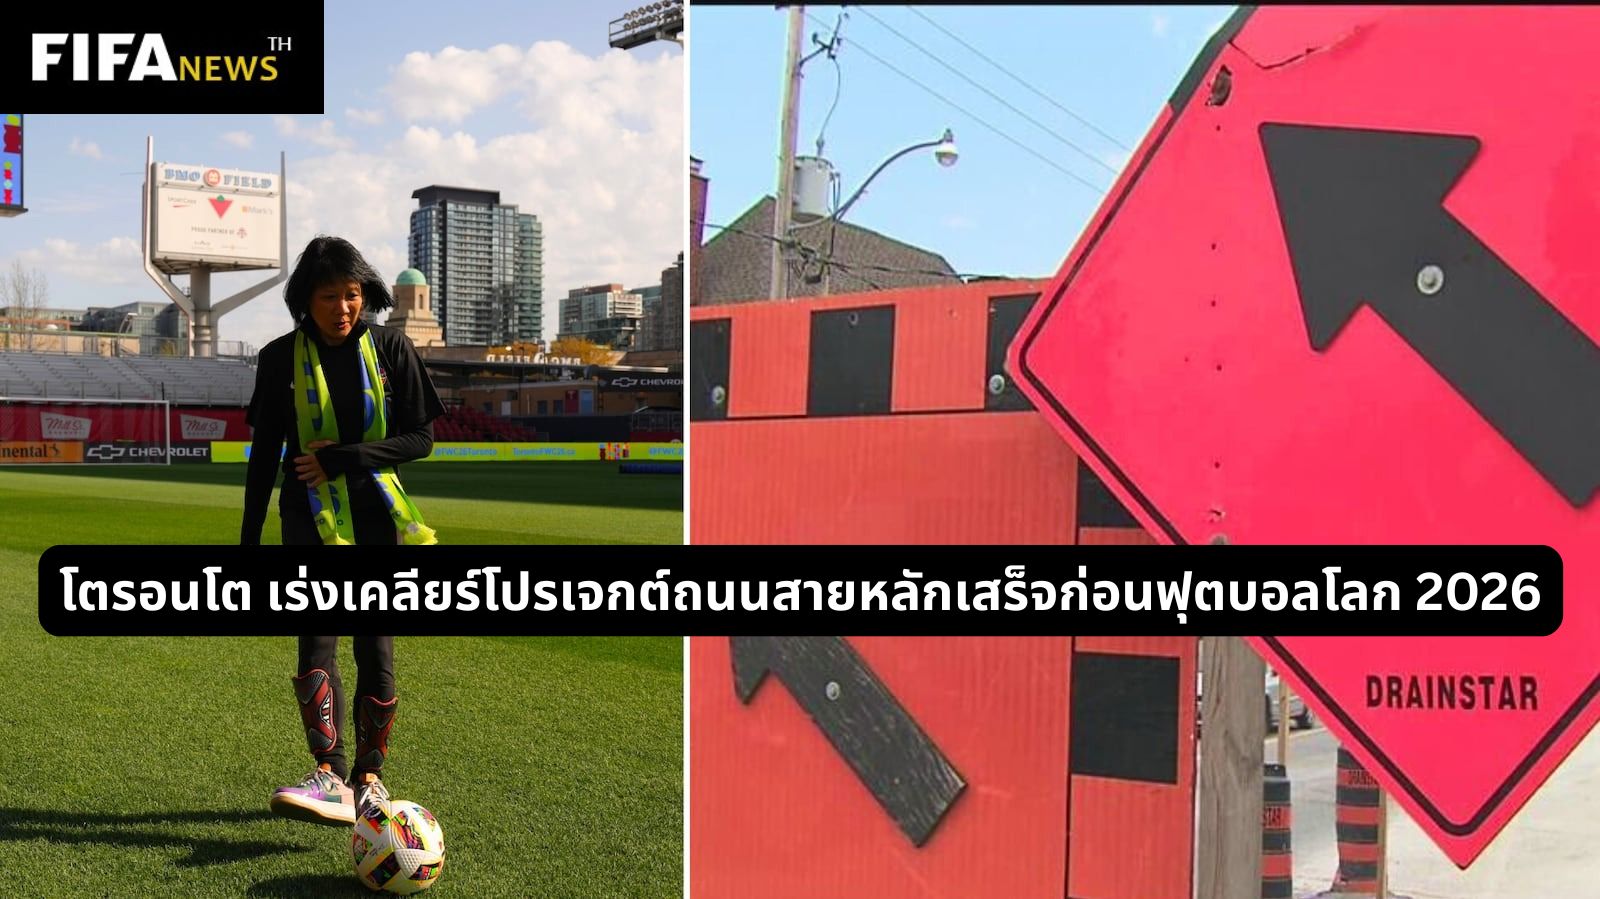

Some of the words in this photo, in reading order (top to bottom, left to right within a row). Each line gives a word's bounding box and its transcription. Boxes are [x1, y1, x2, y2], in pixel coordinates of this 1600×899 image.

[164, 168, 201, 182] BMO
[223, 174, 272, 189] FIELD
[1, 443, 48, 458] nental
[129, 447, 208, 457] CHEVROLET
[1365, 674, 1539, 711] DRAINSTAR
